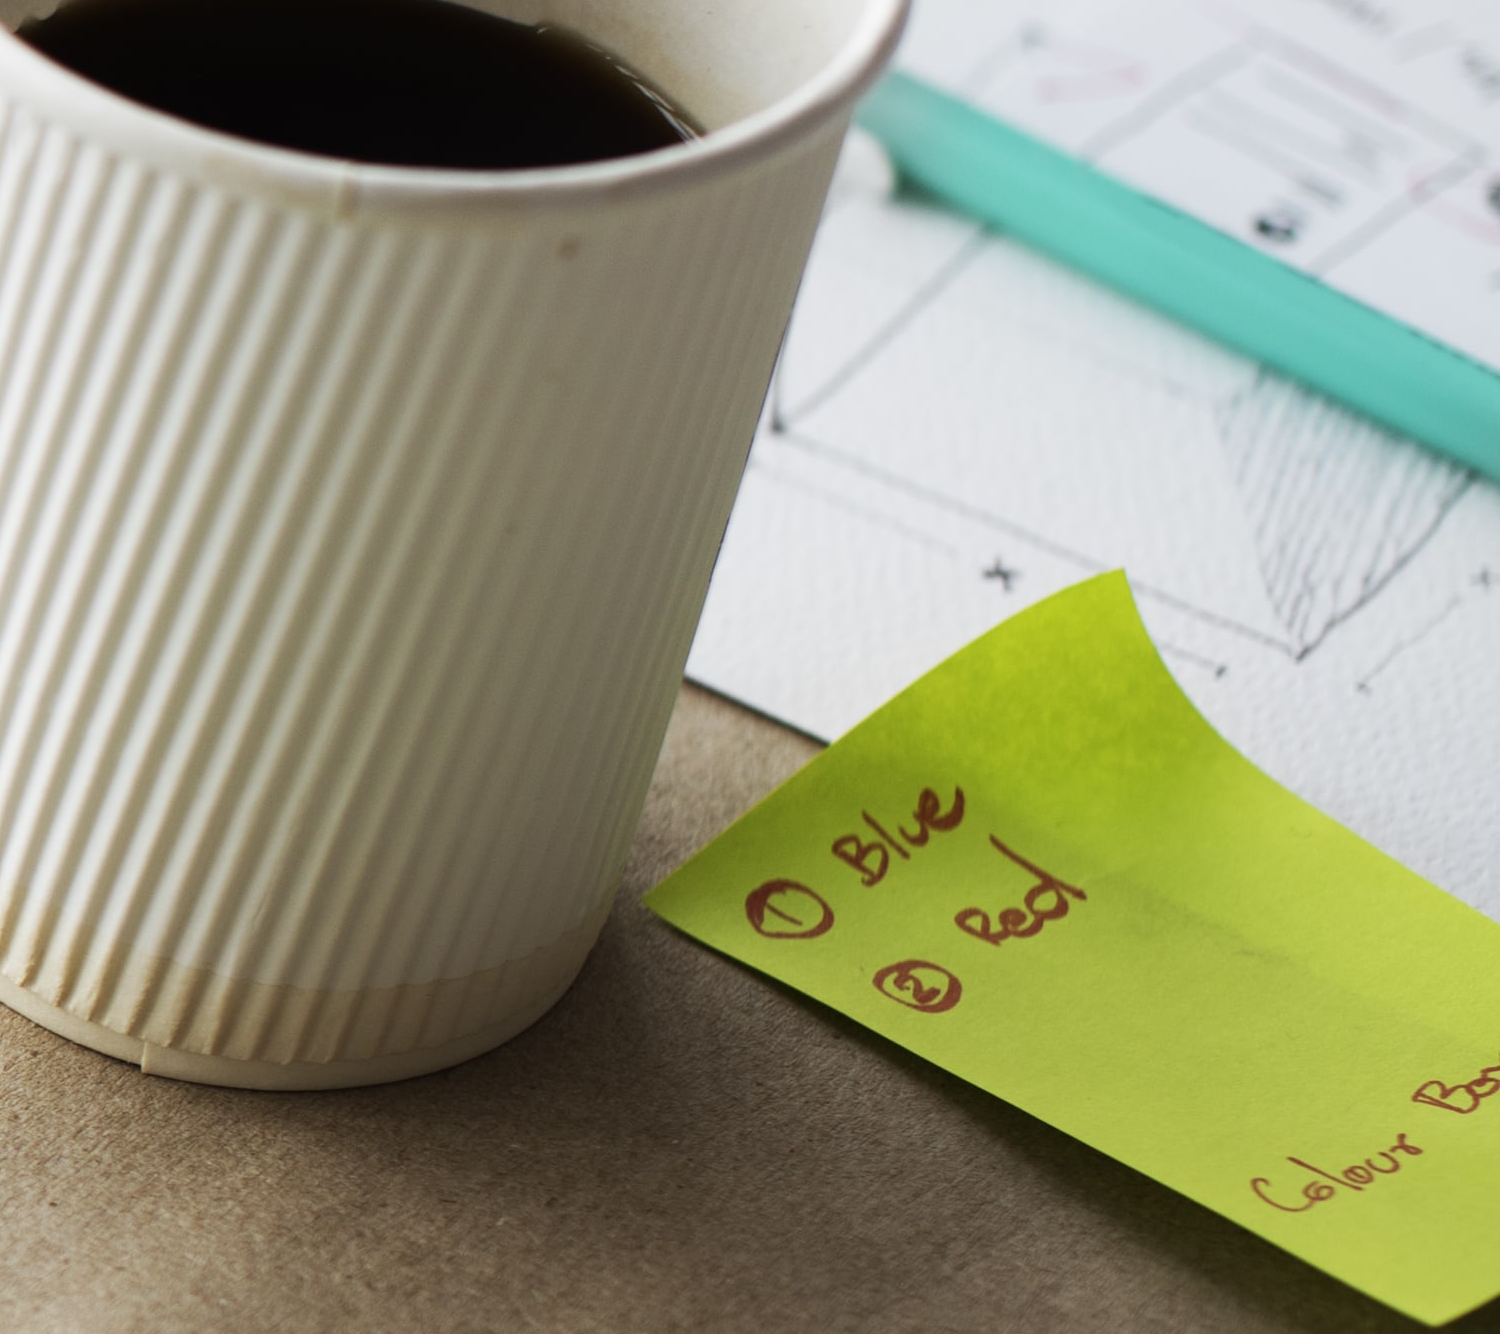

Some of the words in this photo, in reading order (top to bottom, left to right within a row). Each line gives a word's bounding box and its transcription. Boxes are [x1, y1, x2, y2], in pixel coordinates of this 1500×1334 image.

[831, 784, 965, 887] Blue
[954, 833, 1087, 946] Red
[1250, 1132, 1423, 1212] Colour
[1411, 1065, 1500, 1114] Bo
